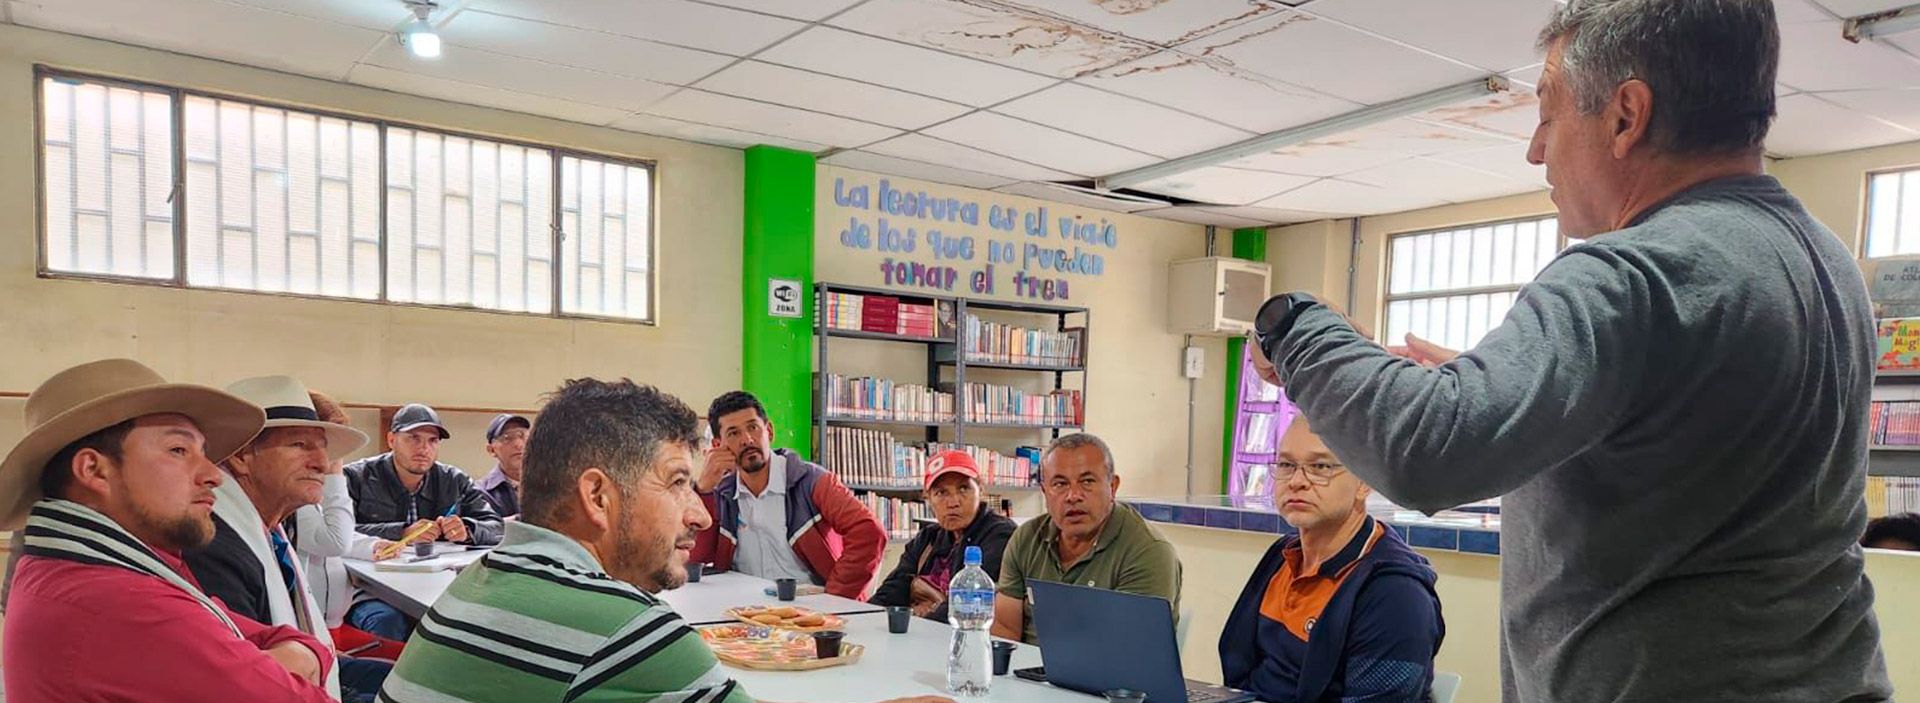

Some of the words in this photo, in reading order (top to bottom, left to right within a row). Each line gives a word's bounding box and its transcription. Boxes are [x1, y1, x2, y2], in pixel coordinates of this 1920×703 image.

[835, 177, 869, 210] La
[878, 178, 978, 226] lectura
[989, 205, 1018, 231] es
[1025, 207, 1048, 237] el
[1059, 215, 1117, 248] viaje
[840, 216, 871, 249] de
[878, 218, 916, 253] los
[927, 229, 975, 260] que
[988, 240, 1015, 264] no
[970, 263, 994, 295] el
[1012, 271, 1069, 301] tren
[776, 304, 796, 313] ZONA
